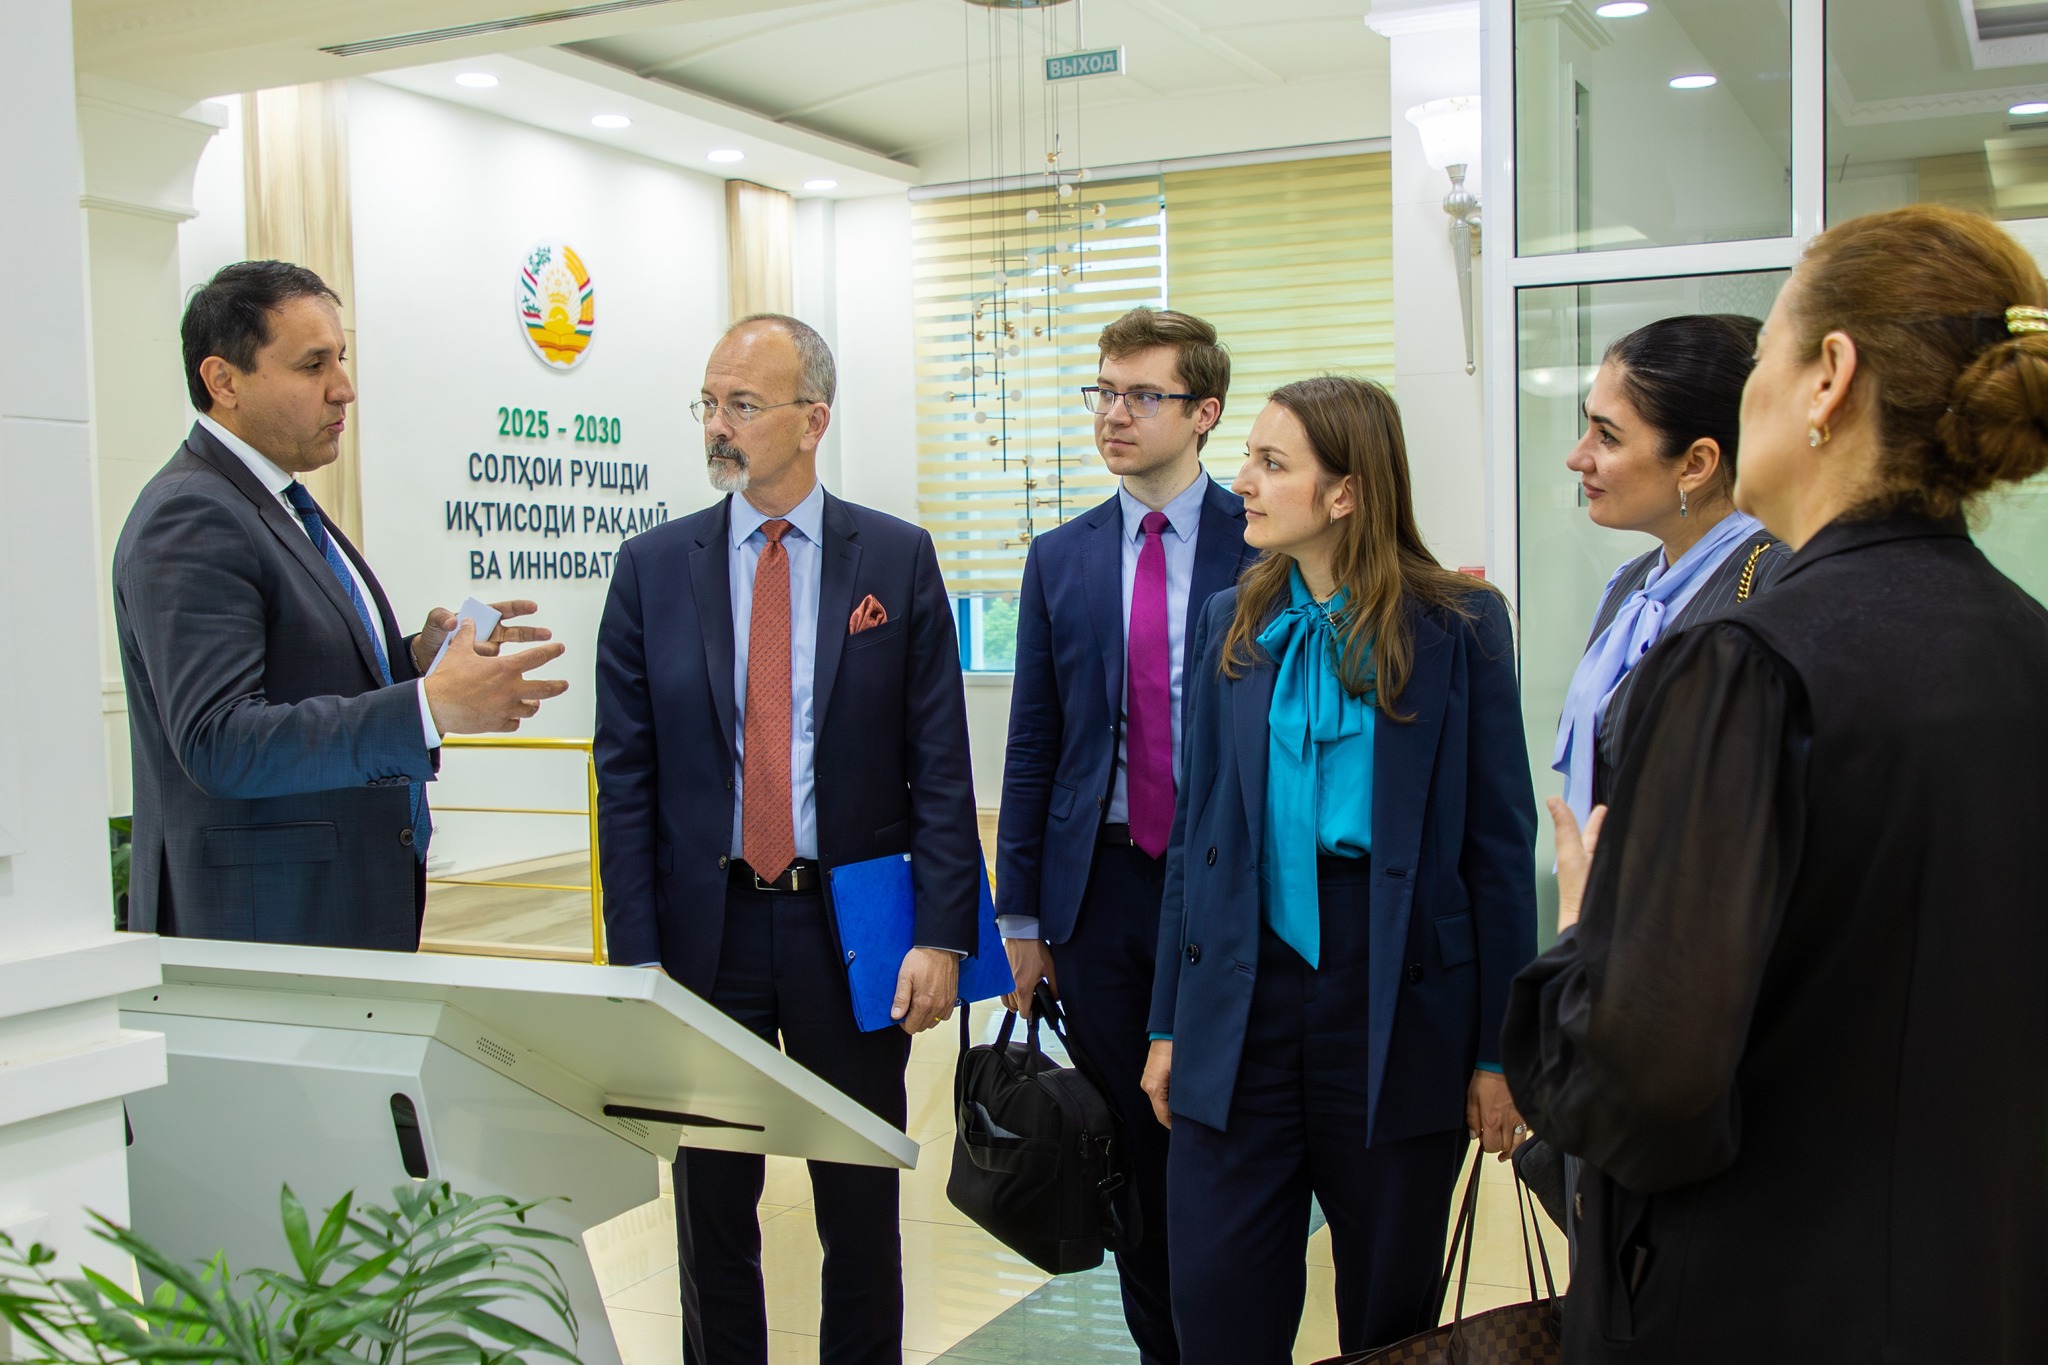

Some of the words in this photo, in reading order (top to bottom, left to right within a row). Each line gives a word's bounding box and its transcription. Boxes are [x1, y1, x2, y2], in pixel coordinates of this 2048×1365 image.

[1049, 53, 1115, 78] ВЫХОД
[498, 406, 549, 439] 2025
[574, 414, 621, 444] 2030
[468, 452, 562, 491] СОЛҲОИ
[570, 459, 648, 495] РУШДИ
[446, 500, 575, 538] ИҚТИСОДИ
[470, 550, 502, 580] ВА
